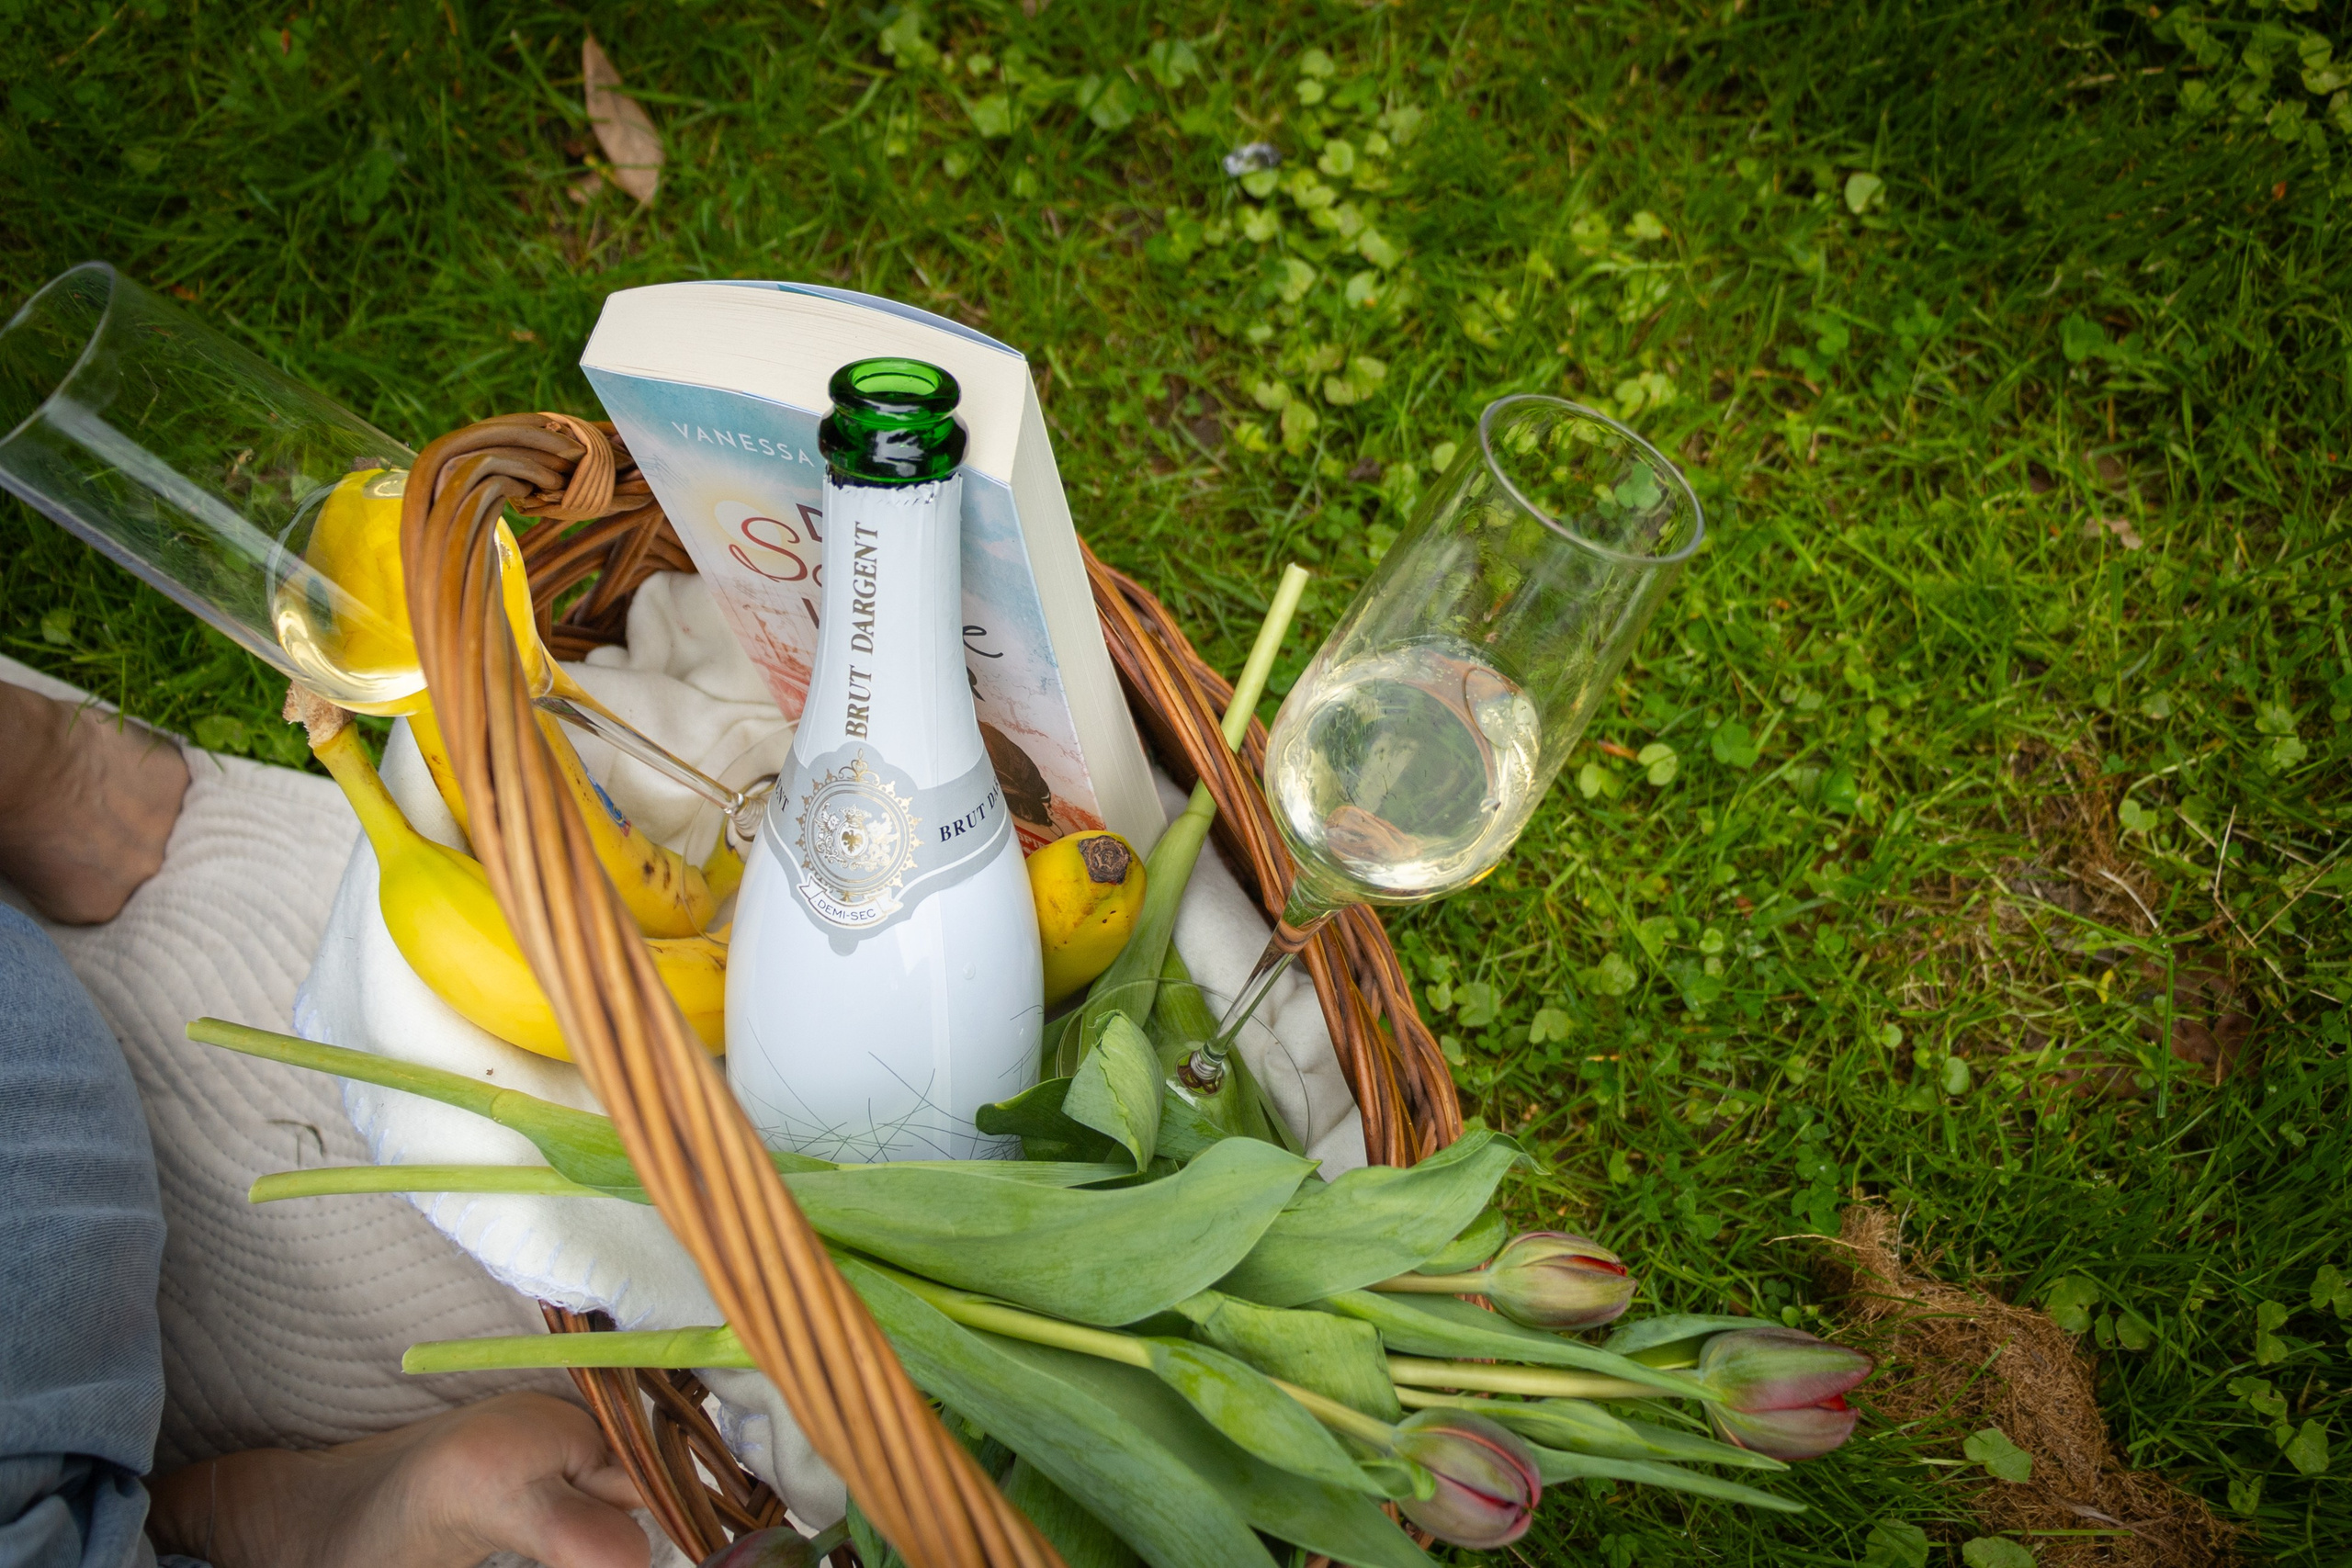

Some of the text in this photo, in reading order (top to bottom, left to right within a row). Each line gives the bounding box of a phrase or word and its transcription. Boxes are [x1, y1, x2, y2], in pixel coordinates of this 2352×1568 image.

[671, 421, 816, 468] VANESSA
[845, 521, 878, 741] BRUT DARGENT
[939, 802, 986, 842] BRUT
[817, 898, 876, 921] DEMI-SEC
